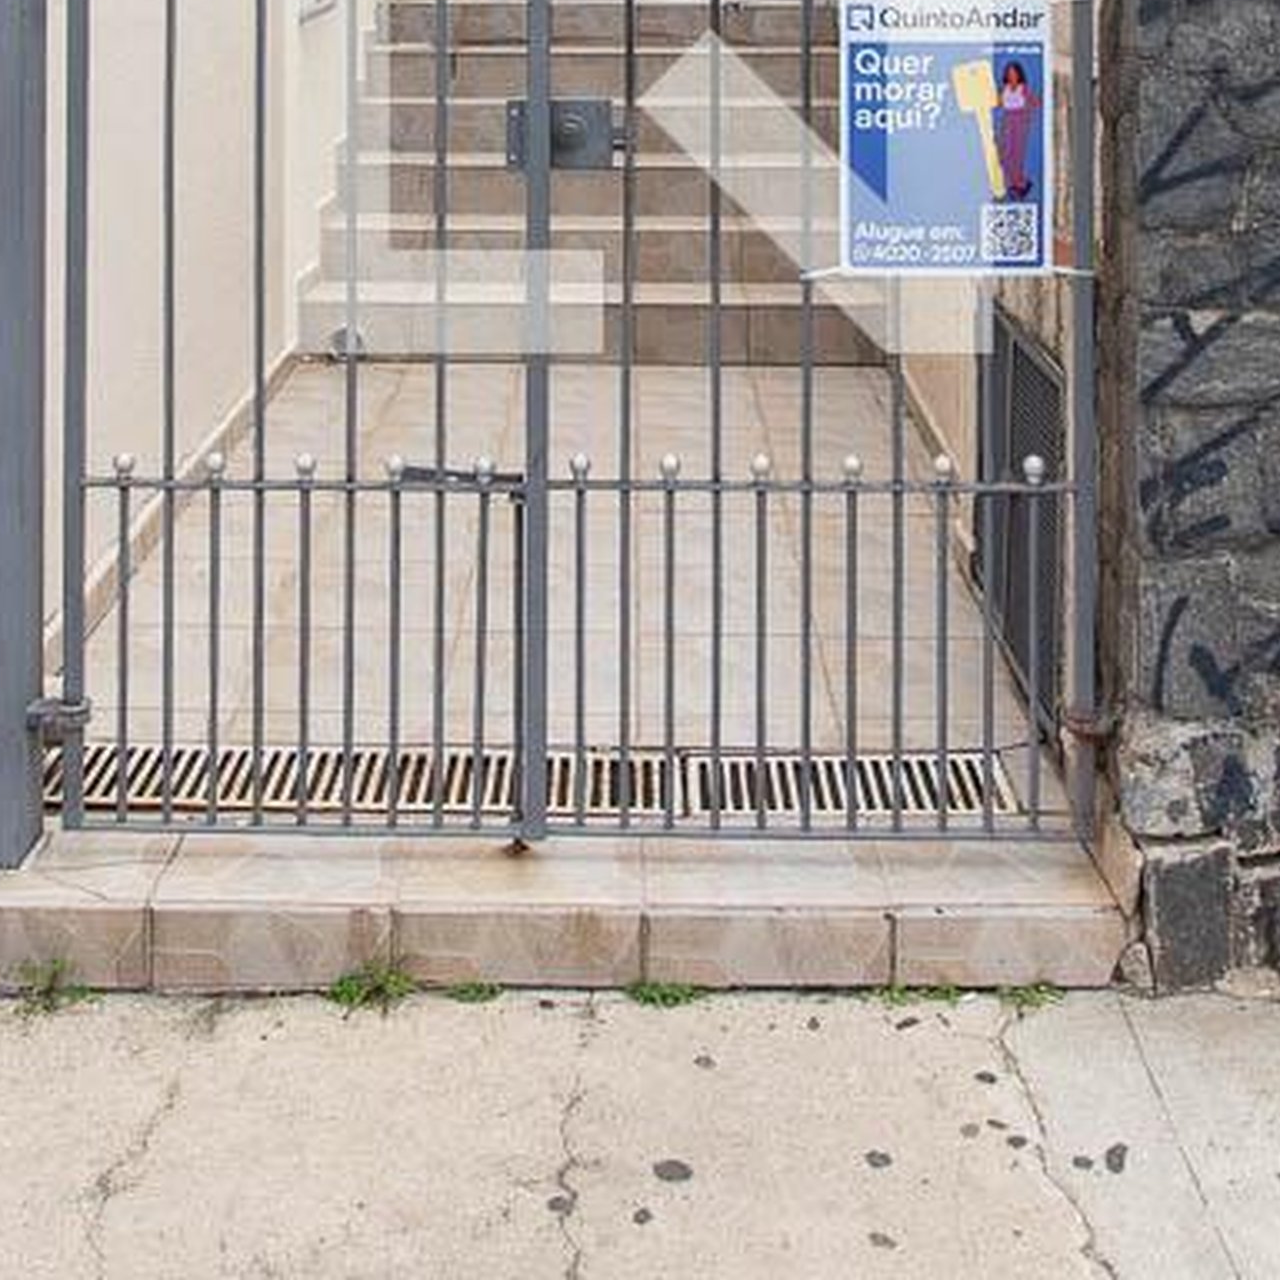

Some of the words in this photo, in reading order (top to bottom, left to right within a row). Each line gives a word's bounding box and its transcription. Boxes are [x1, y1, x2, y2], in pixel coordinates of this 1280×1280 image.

[879, 6, 1044, 30] QuintoAndar
[854, 49, 934, 78] Quer
[854, 81, 948, 102] morar
[854, 102, 941, 135] aqui?
